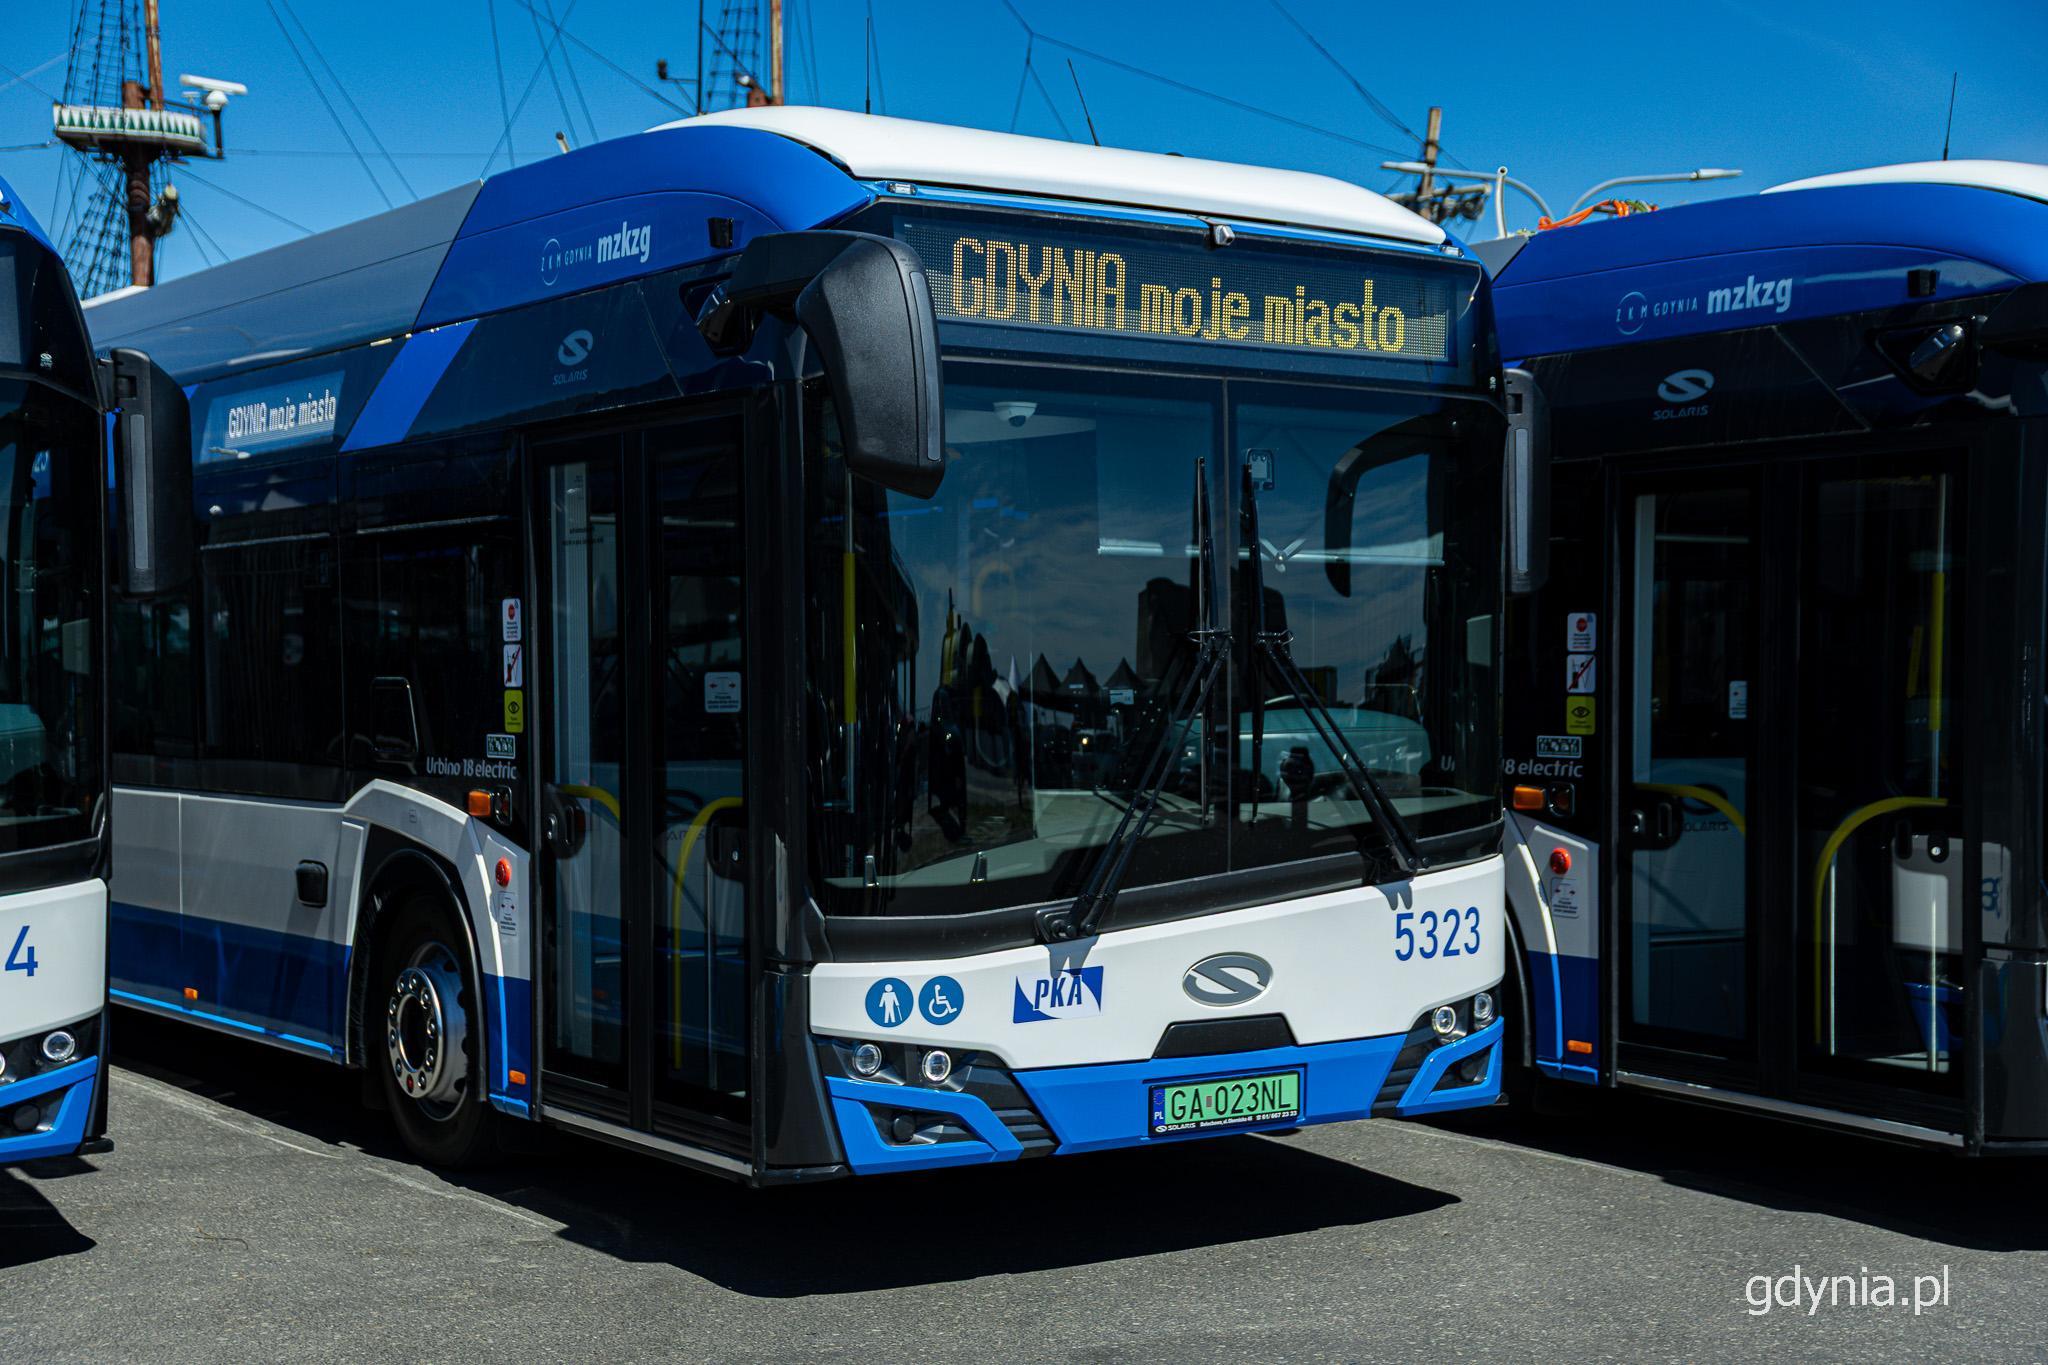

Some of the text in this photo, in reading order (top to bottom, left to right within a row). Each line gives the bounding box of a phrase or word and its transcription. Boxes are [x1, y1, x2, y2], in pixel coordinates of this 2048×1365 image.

[564, 245, 592, 267] GDYNIA
[597, 221, 651, 264] mzkzg
[952, 237, 1406, 353] GDYNIA moje miasto
[1653, 297, 1698, 318] GDYNIA
[1707, 275, 1793, 315] mzkzg
[553, 369, 588, 385] SOLARIS
[228, 388, 337, 439] GDYNIA moje miasto
[1653, 405, 1709, 421] SOLARIS
[426, 755, 517, 780] Urbino 18 electric
[1518, 758, 1584, 778] electric
[1395, 906, 1480, 961] 5323
[5, 925, 38, 977] 4
[1034, 975, 1082, 1010] PKA
[1171, 1079, 1291, 1120] GA 023NL
[1154, 1111, 1164, 1120] PL
[1168, 1122, 1196, 1131] SOLARIS
